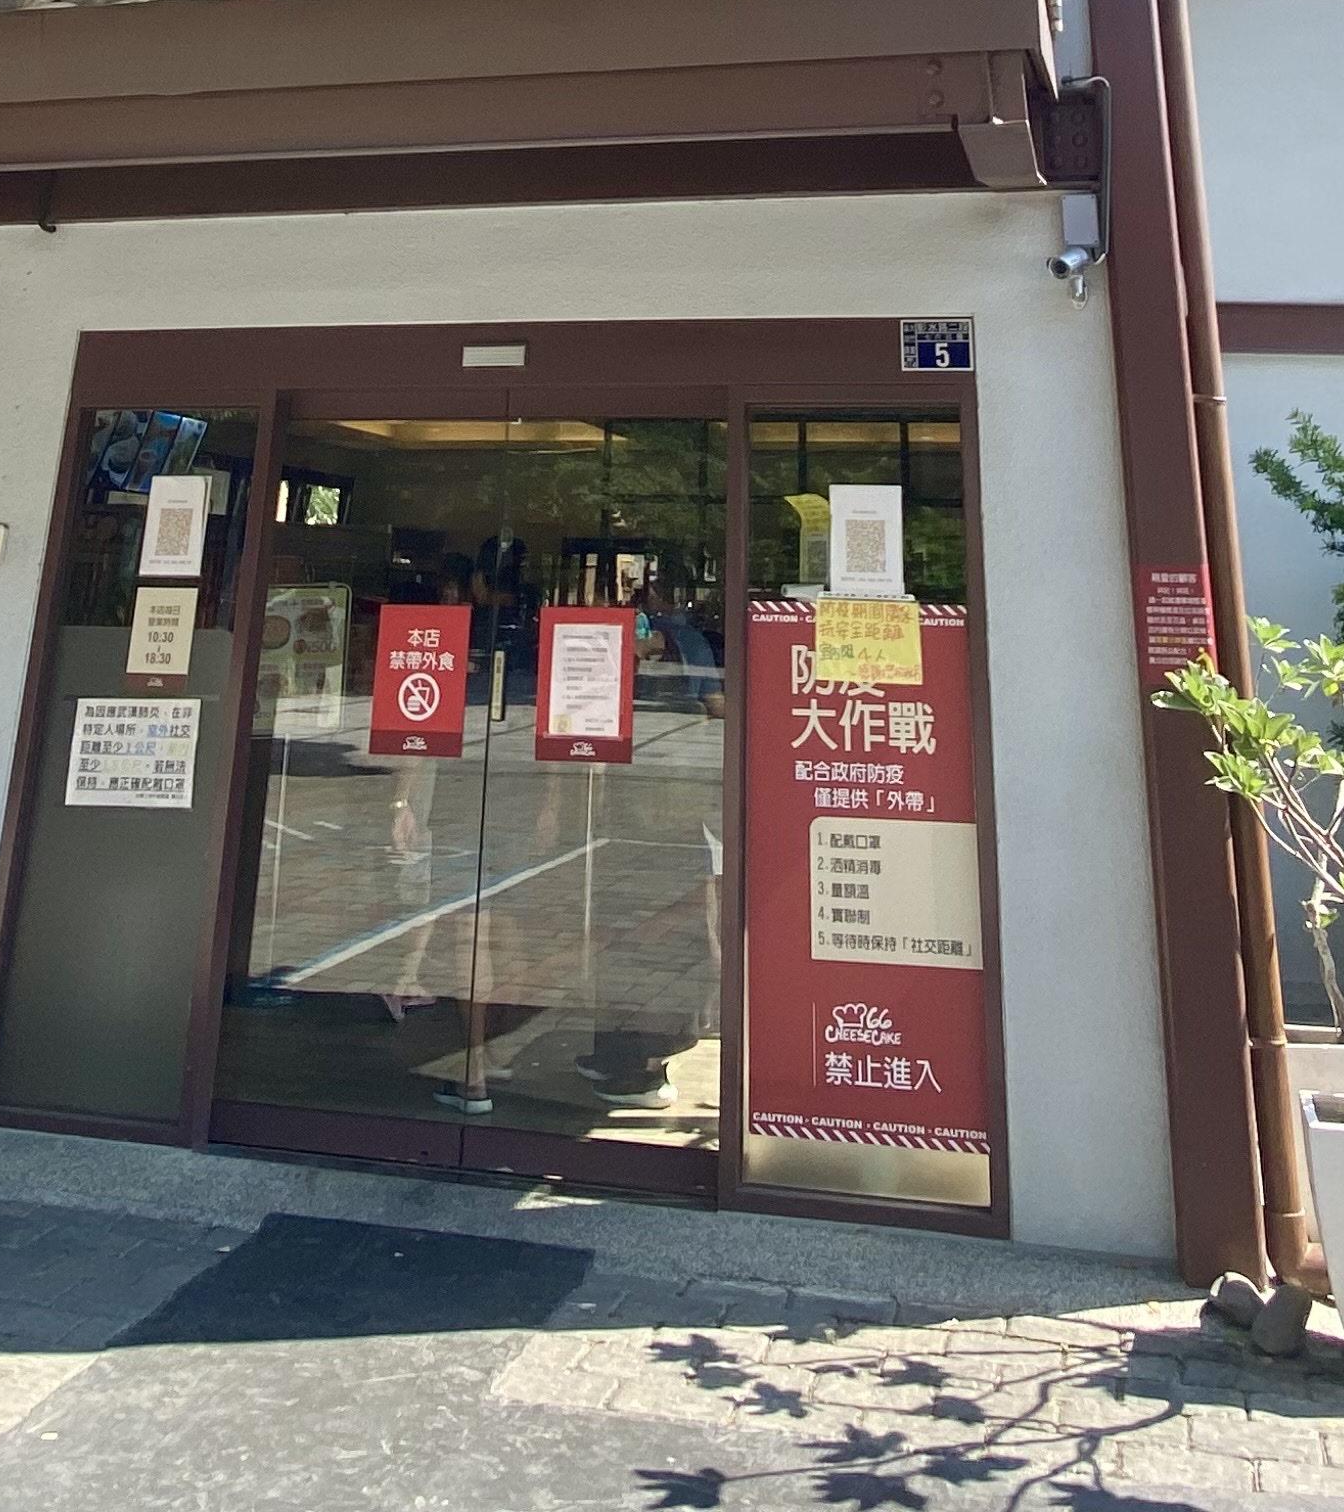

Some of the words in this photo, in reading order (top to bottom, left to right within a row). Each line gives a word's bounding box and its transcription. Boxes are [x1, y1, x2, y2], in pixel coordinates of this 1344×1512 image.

[935, 342, 950, 368] 5
[752, 614, 798, 623] CAUTION
[147, 631, 174, 643] 10:30
[407, 628, 440, 648] 本店
[145, 653, 171, 665] 18:30
[389, 650, 455, 672] 禁帶外食
[791, 699, 936, 755] 大作戰
[794, 761, 904, 785] 配合政府防疫
[814, 788, 936, 813] 僅提供「外帶」
[865, 1006, 893, 1030] 66
[825, 1024, 902, 1046] CHEESECAKE
[825, 1051, 942, 1093] 禁止進入
[753, 1112, 803, 1124] CAUTION
[812, 1116, 863, 1129] CAUTION
[873, 1121, 925, 1135] CAUTION
[934, 1127, 987, 1140] CAUTION
